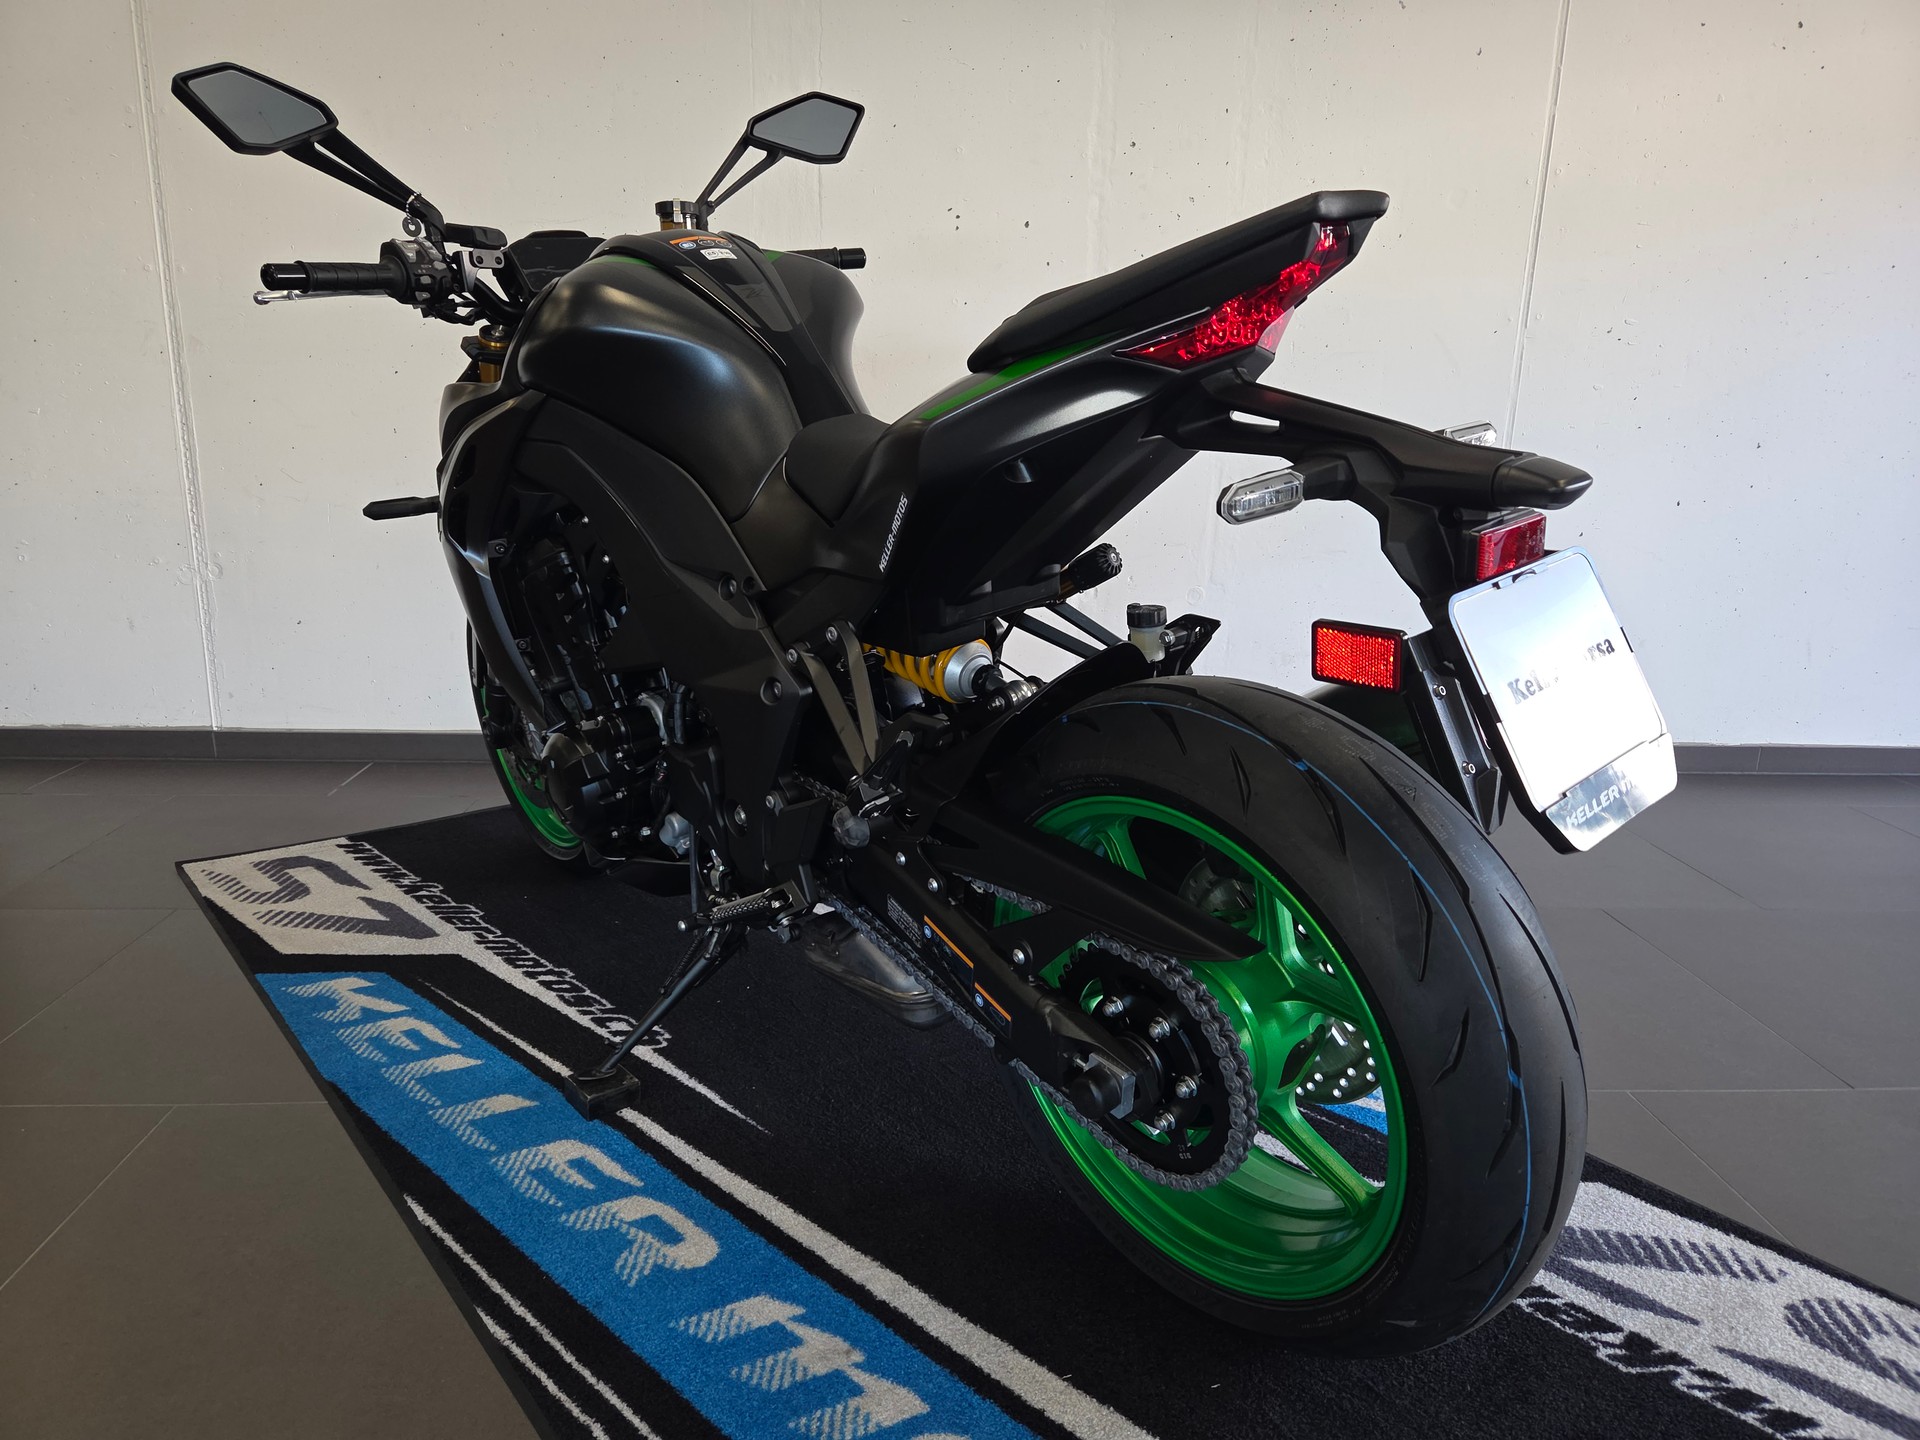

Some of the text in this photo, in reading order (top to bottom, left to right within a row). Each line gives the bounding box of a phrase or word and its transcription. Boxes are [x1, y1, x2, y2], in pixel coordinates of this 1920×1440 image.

[877, 494, 908, 573] KELLER-MOTOS
[1565, 784, 1621, 829] KELLER
[281, 977, 720, 1286] KELLER
